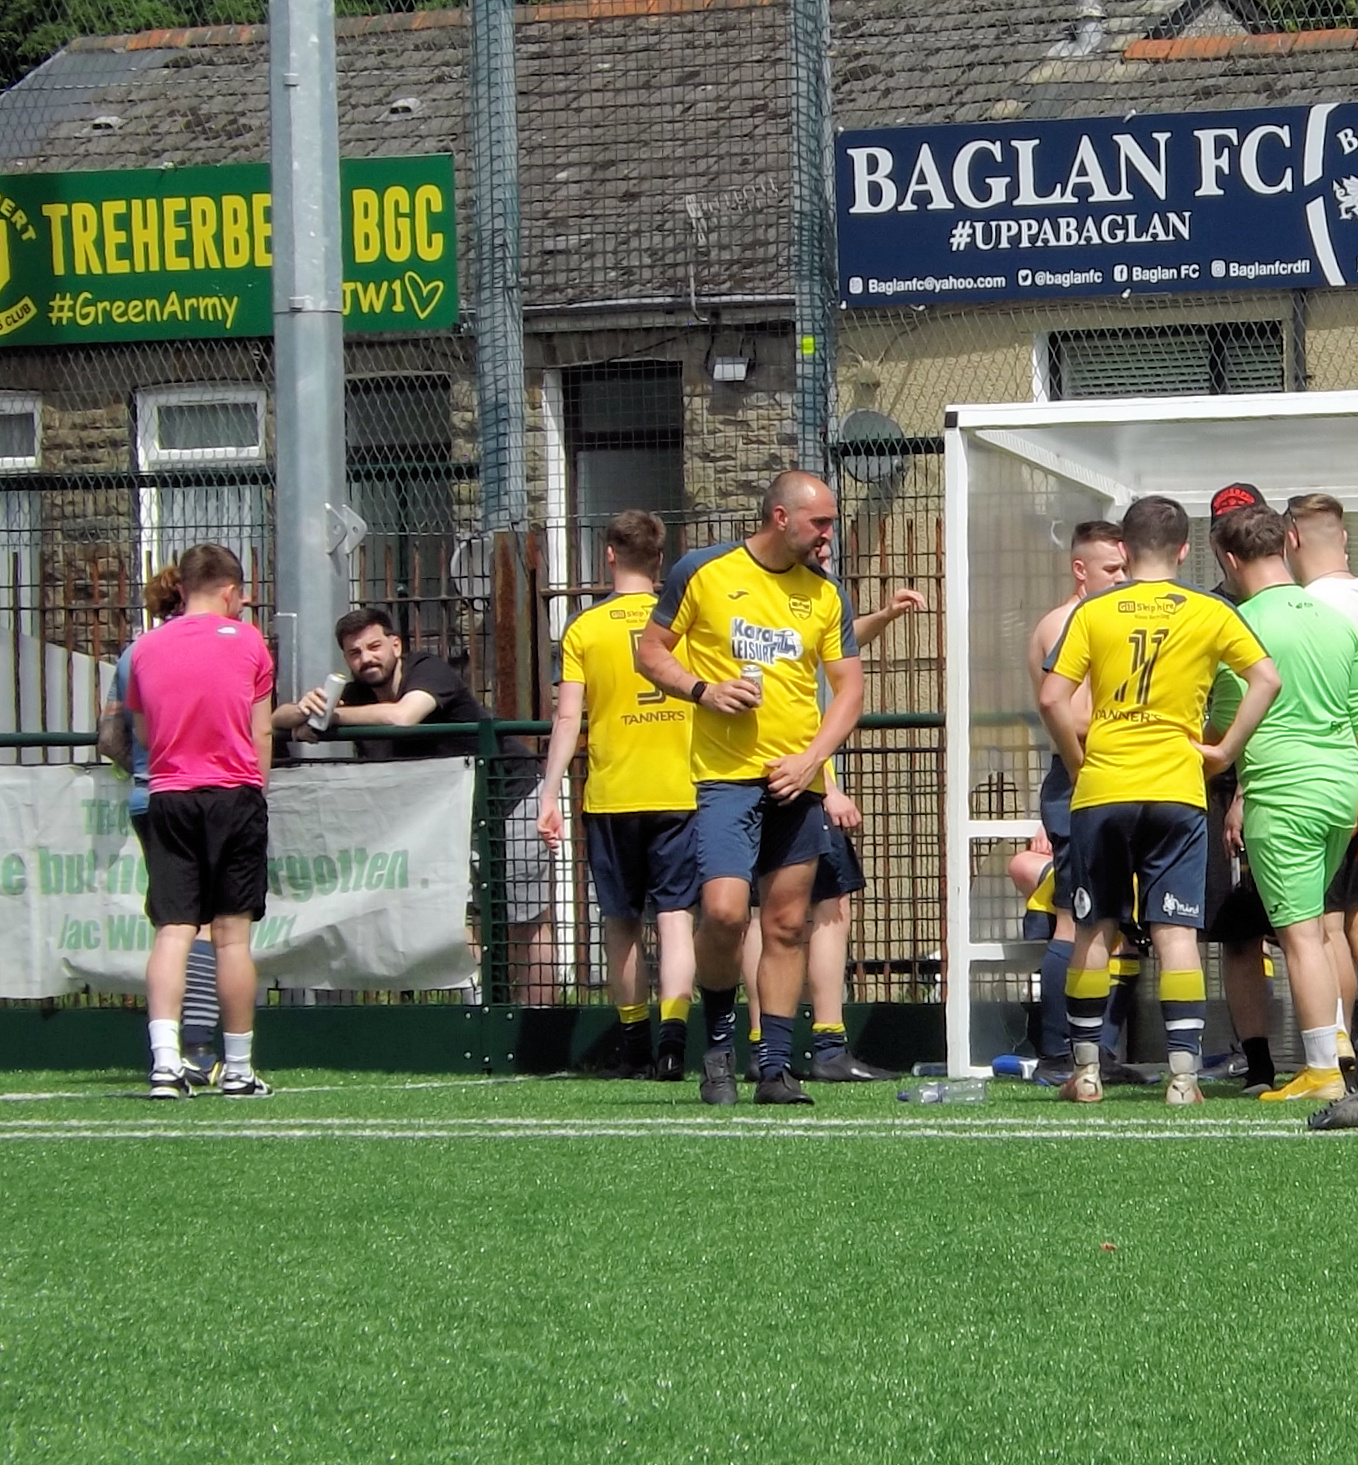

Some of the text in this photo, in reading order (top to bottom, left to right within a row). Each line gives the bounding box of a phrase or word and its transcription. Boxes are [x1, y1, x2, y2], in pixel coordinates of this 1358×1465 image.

[846, 123, 1293, 215] BAGLAN FC
[352, 184, 443, 263] BGC
[949, 211, 1193, 252] #UPPABAGLAN
[868, 275, 1006, 295] Baglanfc@yahoo.com
[1034, 268, 1103, 288] @baglanfc
[1131, 265, 1179, 283] Baglan
[1180, 264, 1200, 279] FC
[5, 303, 31, 327] CLUB
[47, 290, 238, 329] #GreenArmy
[732, 617, 774, 643] Kara
[732, 640, 776, 665] LEISURE
[1114, 628, 1170, 706] 11
[621, 711, 685, 726] TANNER'S
[38, 846, 99, 895] but
